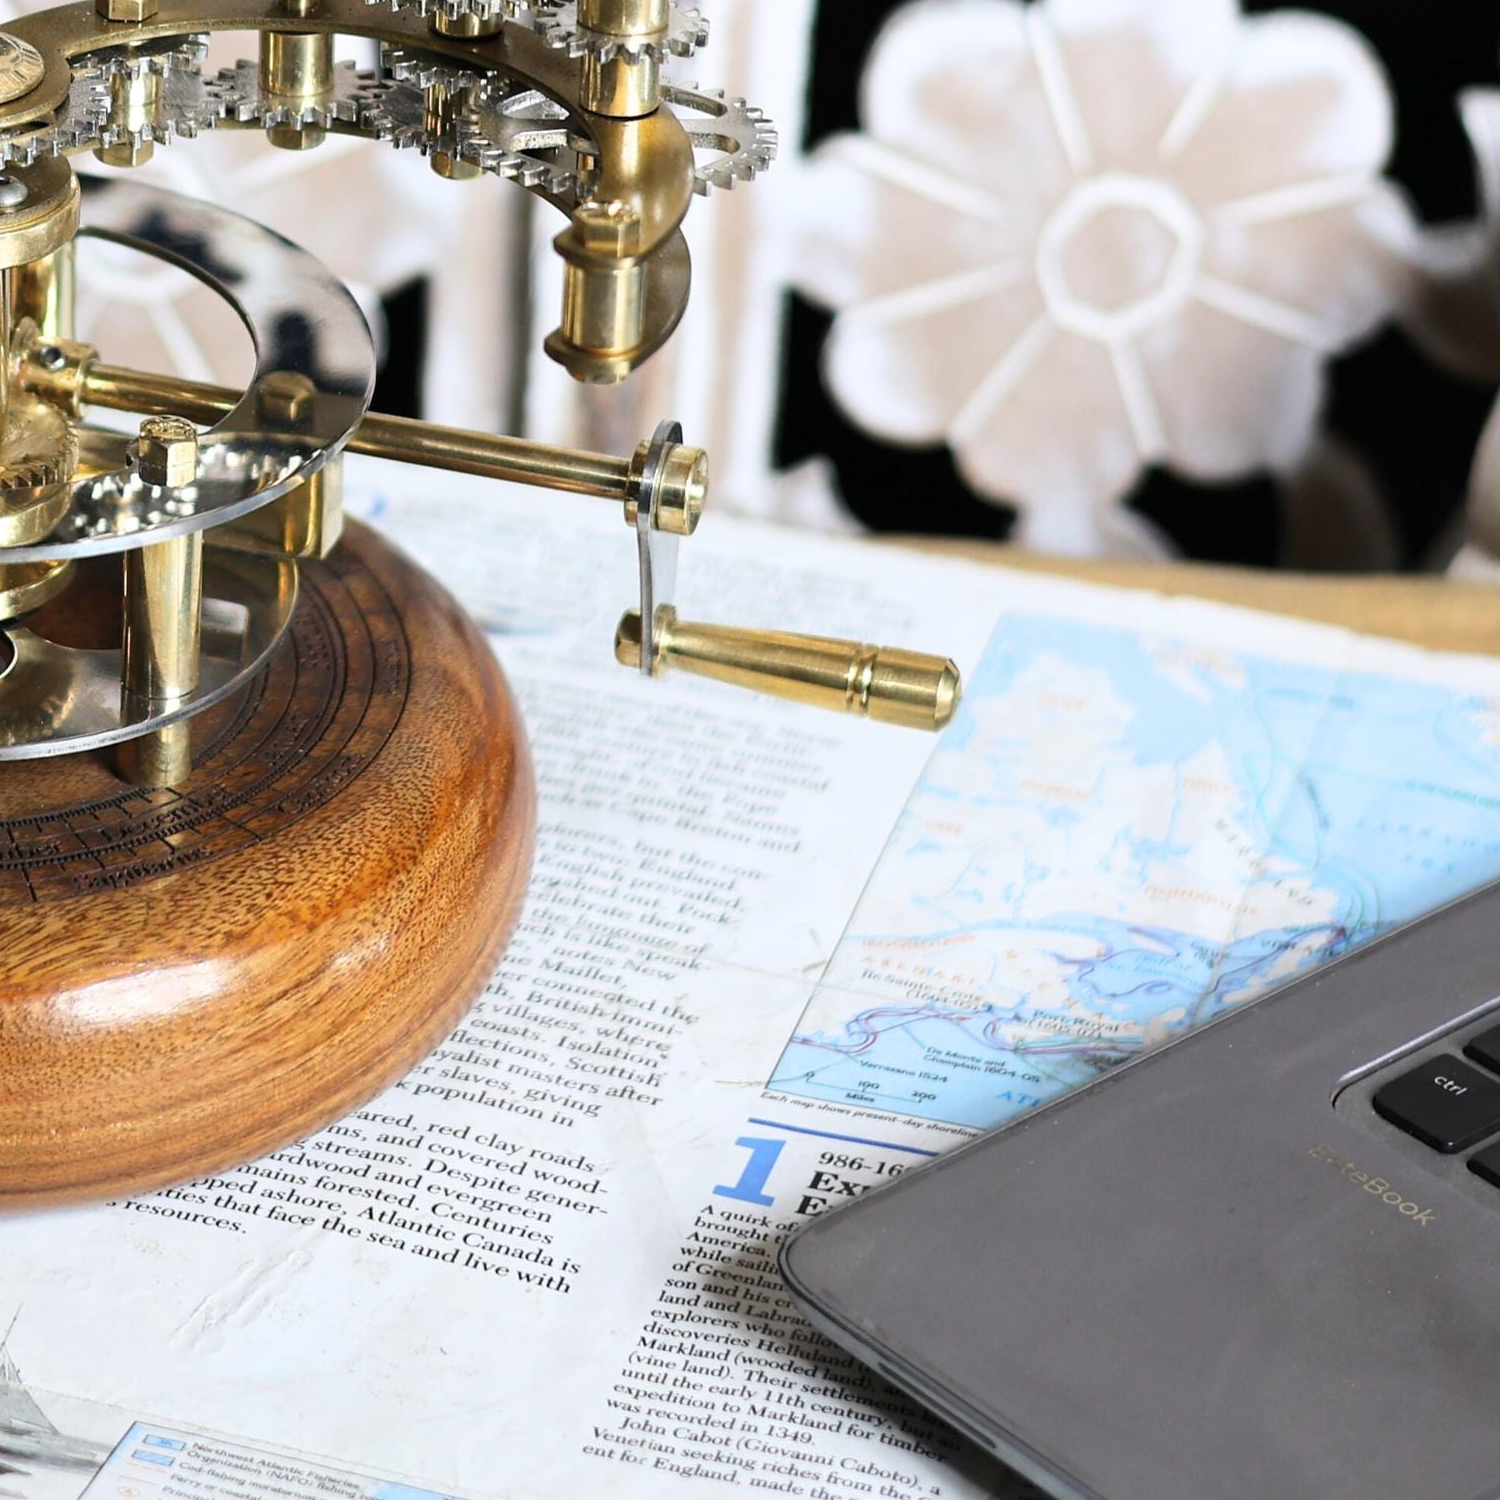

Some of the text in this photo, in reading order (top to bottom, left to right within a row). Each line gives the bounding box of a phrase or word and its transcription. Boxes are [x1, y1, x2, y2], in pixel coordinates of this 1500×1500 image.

[492, 1003, 586, 1036] villages,
[470, 1017, 660, 1070] coasts. Isolation
[440, 1065, 601, 1117] slaves, giving
[507, 1062, 601, 1095] masters
[565, 1055, 662, 1089] Scottish
[857, 1080, 937, 1101] 100 200
[1434, 1075, 1468, 1096] ctrl
[412, 1084, 573, 1126] population in
[760, 1091, 788, 1103] Each
[797, 1098, 815, 1110] map
[816, 1102, 851, 1115] shows
[853, 1109, 924, 1130] present-day
[846, 1092, 875, 1103] Miles
[376, 1134, 606, 1193] and covered wood-
[427, 1124, 594, 1172] red clay roads
[312, 1141, 607, 1213] streams. Despite gener-
[712, 1136, 787, 1207] 1
[807, 1170, 871, 1197] Ex
[124, 1201, 245, 1233] resources.
[316, 1176, 552, 1243] forested. Centuries
[374, 1172, 551, 1222] and evergreen
[260, 1188, 580, 1273] ashore, Atlantic Canada is
[694, 1216, 768, 1241] brought
[701, 1204, 796, 1233] A quirk of
[214, 1195, 569, 1291] that face the sea and live with
[681, 1246, 732, 1263] while
[687, 1231, 770, 1257] America.
[650, 1309, 739, 1328] explorers
[628, 1351, 676, 1368] (vine
[682, 1359, 738, 1381] land).
[744, 1369, 796, 1389] Their
[637, 1336, 823, 1377] Markland (wooded
[621, 1369, 898, 1429] until the early 11th century,
[607, 1399, 819, 1446] was recorded in 1349.
[613, 1385, 951, 1464] expedition to Markland for timber
[187, 1450, 262, 1476] Organization
[192, 1442, 255, 1464] Northwest
[257, 1458, 305, 1477] Atlantic
[618, 1417, 939, 1495] John Cabot (Giovanni Caboto), a
[681, 1449, 756, 1470] seeking
[761, 1461, 820, 1480] riches
[826, 1471, 872, 1492] from
